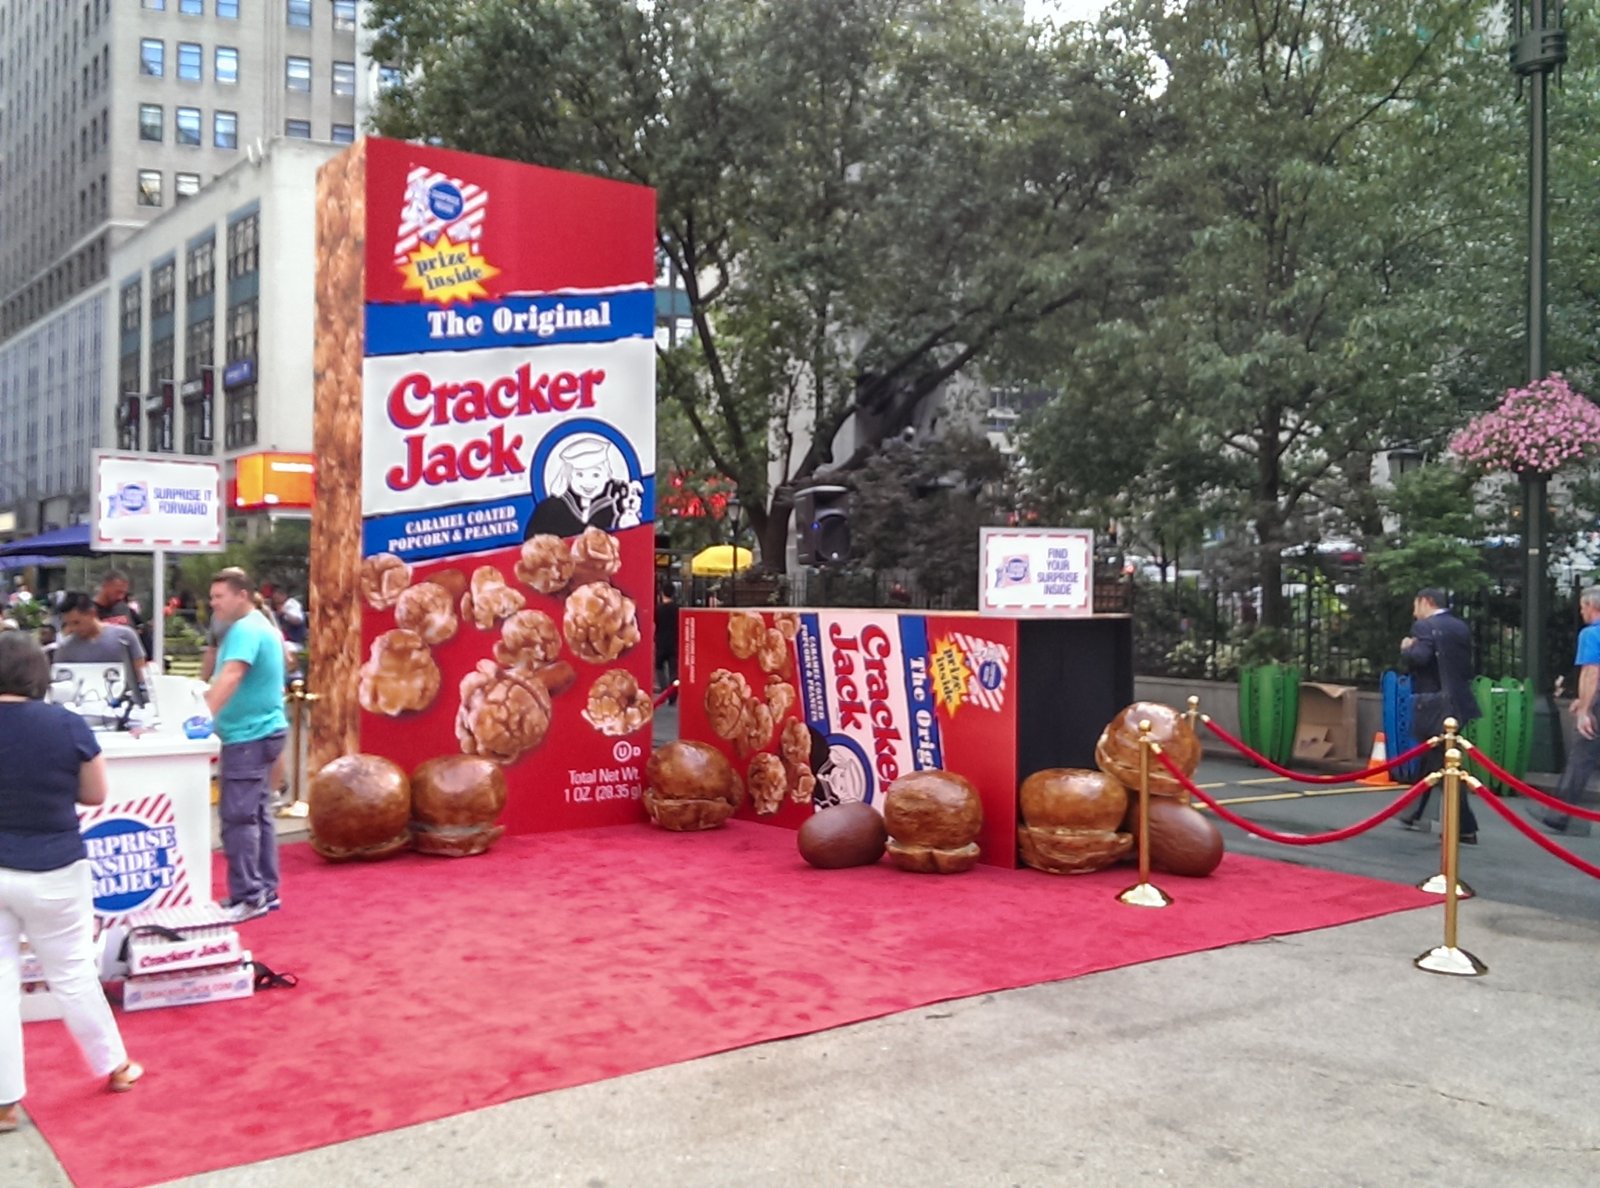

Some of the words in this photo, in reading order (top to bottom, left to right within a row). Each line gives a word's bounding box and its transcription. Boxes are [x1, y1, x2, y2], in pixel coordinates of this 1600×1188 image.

[415, 251, 466, 276] prize
[425, 265, 482, 290] inside
[427, 309, 483, 338] The
[492, 301, 611, 337] Original
[387, 362, 606, 429] Cracker
[385, 423, 526, 491] Jack
[153, 487, 201, 500] SURPRISE
[204, 489, 212, 500] IT
[159, 501, 208, 515] FORWARD
[405, 514, 465, 535] CARAMEL
[467, 505, 516, 524] COATED
[388, 530, 450, 551] POPCORN
[452, 529, 462, 541] &
[465, 520, 518, 540] PEANUTS
[1046, 560, 1069, 571] YOUR
[1047, 548, 1068, 559] FIND
[1037, 572, 1078, 583] SURPRISE
[1043, 584, 1071, 595] INSIDE
[829, 622, 867, 731] Jack
[910, 657, 926, 701] The
[936, 657, 953, 703] inside
[943, 649, 961, 690] prize
[916, 709, 936, 770] Orig
[568, 769, 597, 785] Total
[599, 768, 619, 782] Net
[564, 788, 570, 803] 1
[86, 828, 176, 859] RPRISE
[91, 850, 158, 880] NSIDE
[94, 867, 174, 898] OJECT
[140, 950, 195, 968] Cracker
[198, 942, 230, 957] Jack
